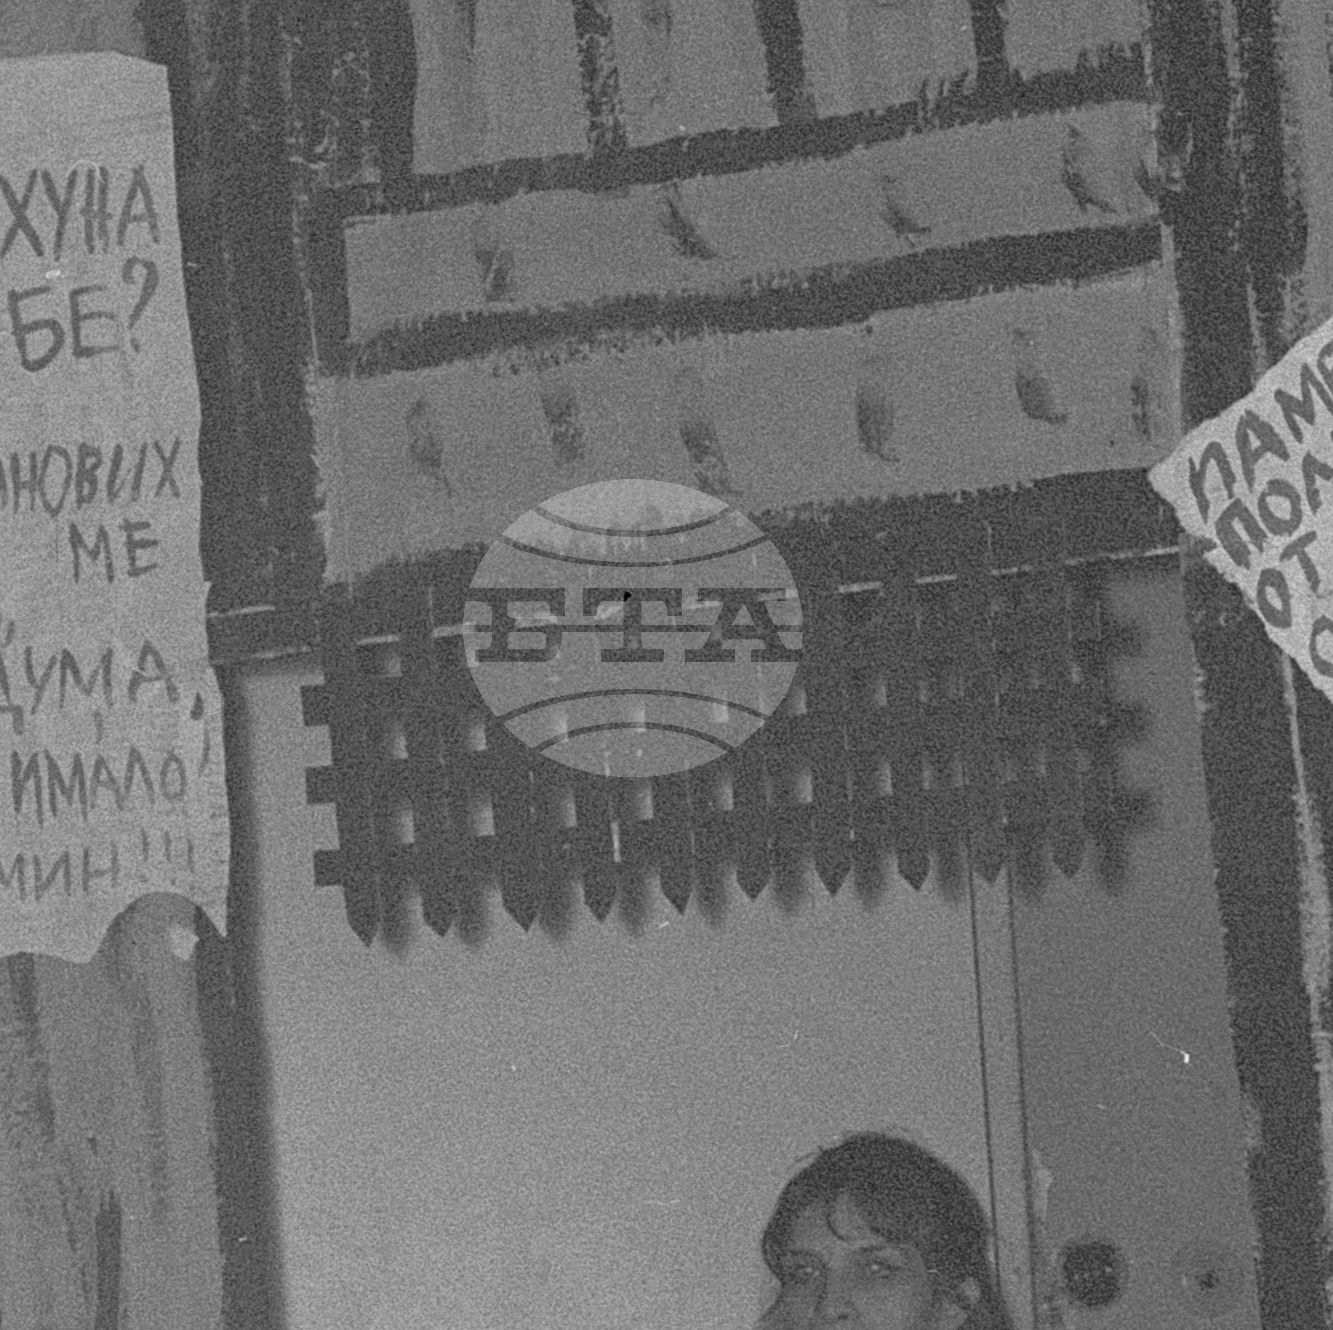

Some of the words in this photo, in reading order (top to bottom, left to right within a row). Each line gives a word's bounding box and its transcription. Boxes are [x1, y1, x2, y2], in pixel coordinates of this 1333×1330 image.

[7, 256, 160, 372] БЕ?
[0, 438, 181, 517] НОВИХ
[68, 518, 158, 583] МЕ
[1256, 530, 1322, 629] ОТ
